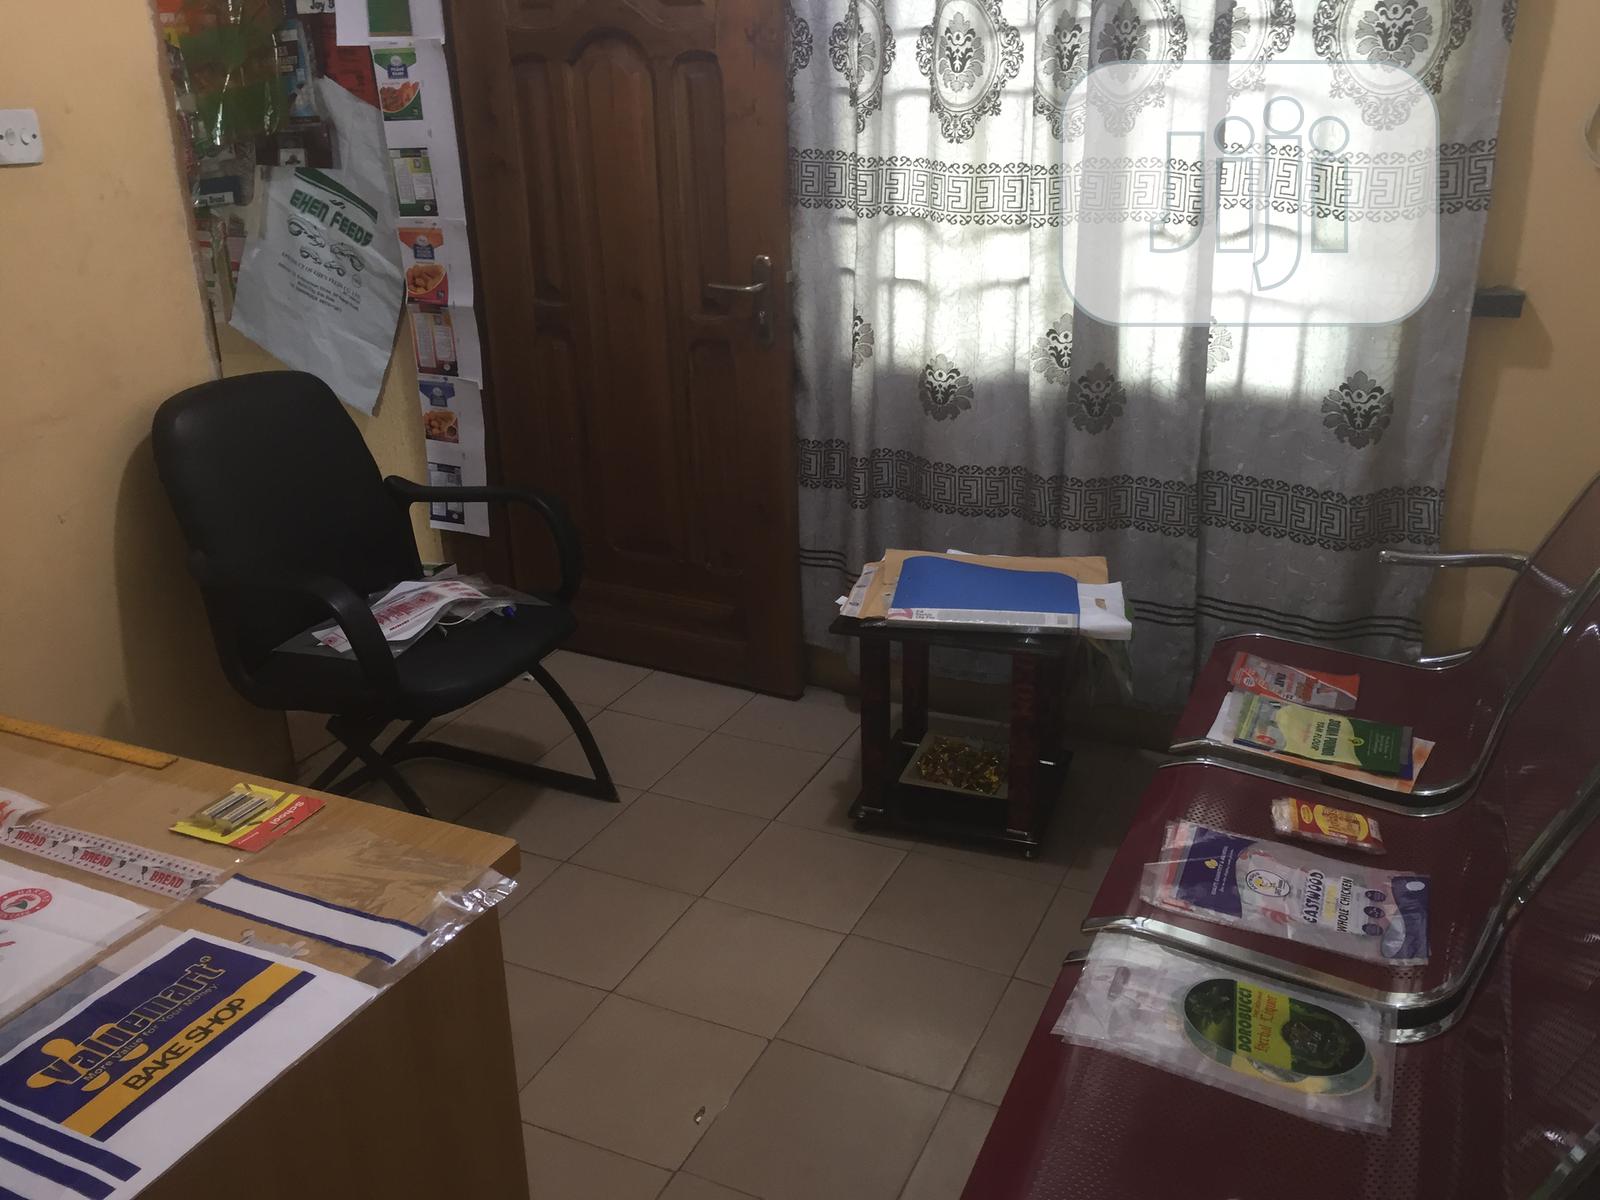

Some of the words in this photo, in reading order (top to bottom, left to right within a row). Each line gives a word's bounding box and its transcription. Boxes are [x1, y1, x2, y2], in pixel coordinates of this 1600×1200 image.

[330, 211, 373, 247] FEEDS
[15, 830, 46, 847] BREAD
[80, 850, 113, 868] BREAD
[150, 870, 184, 889] BREAD
[1339, 878, 1353, 906] CHICKEN
[1303, 871, 1324, 924] EASTWOOD
[1336, 908, 1349, 932] WHOLE
[83, 1058, 113, 1083] More
[115, 1036, 143, 1060] Value
[145, 1023, 160, 1036] for
[159, 1006, 186, 1024] Your
[186, 983, 219, 1007] Money
[1238, 987, 1252, 1054] DOROBUCCI
[122, 1042, 193, 1091] BAKE
[185, 998, 245, 1044] SHOP
